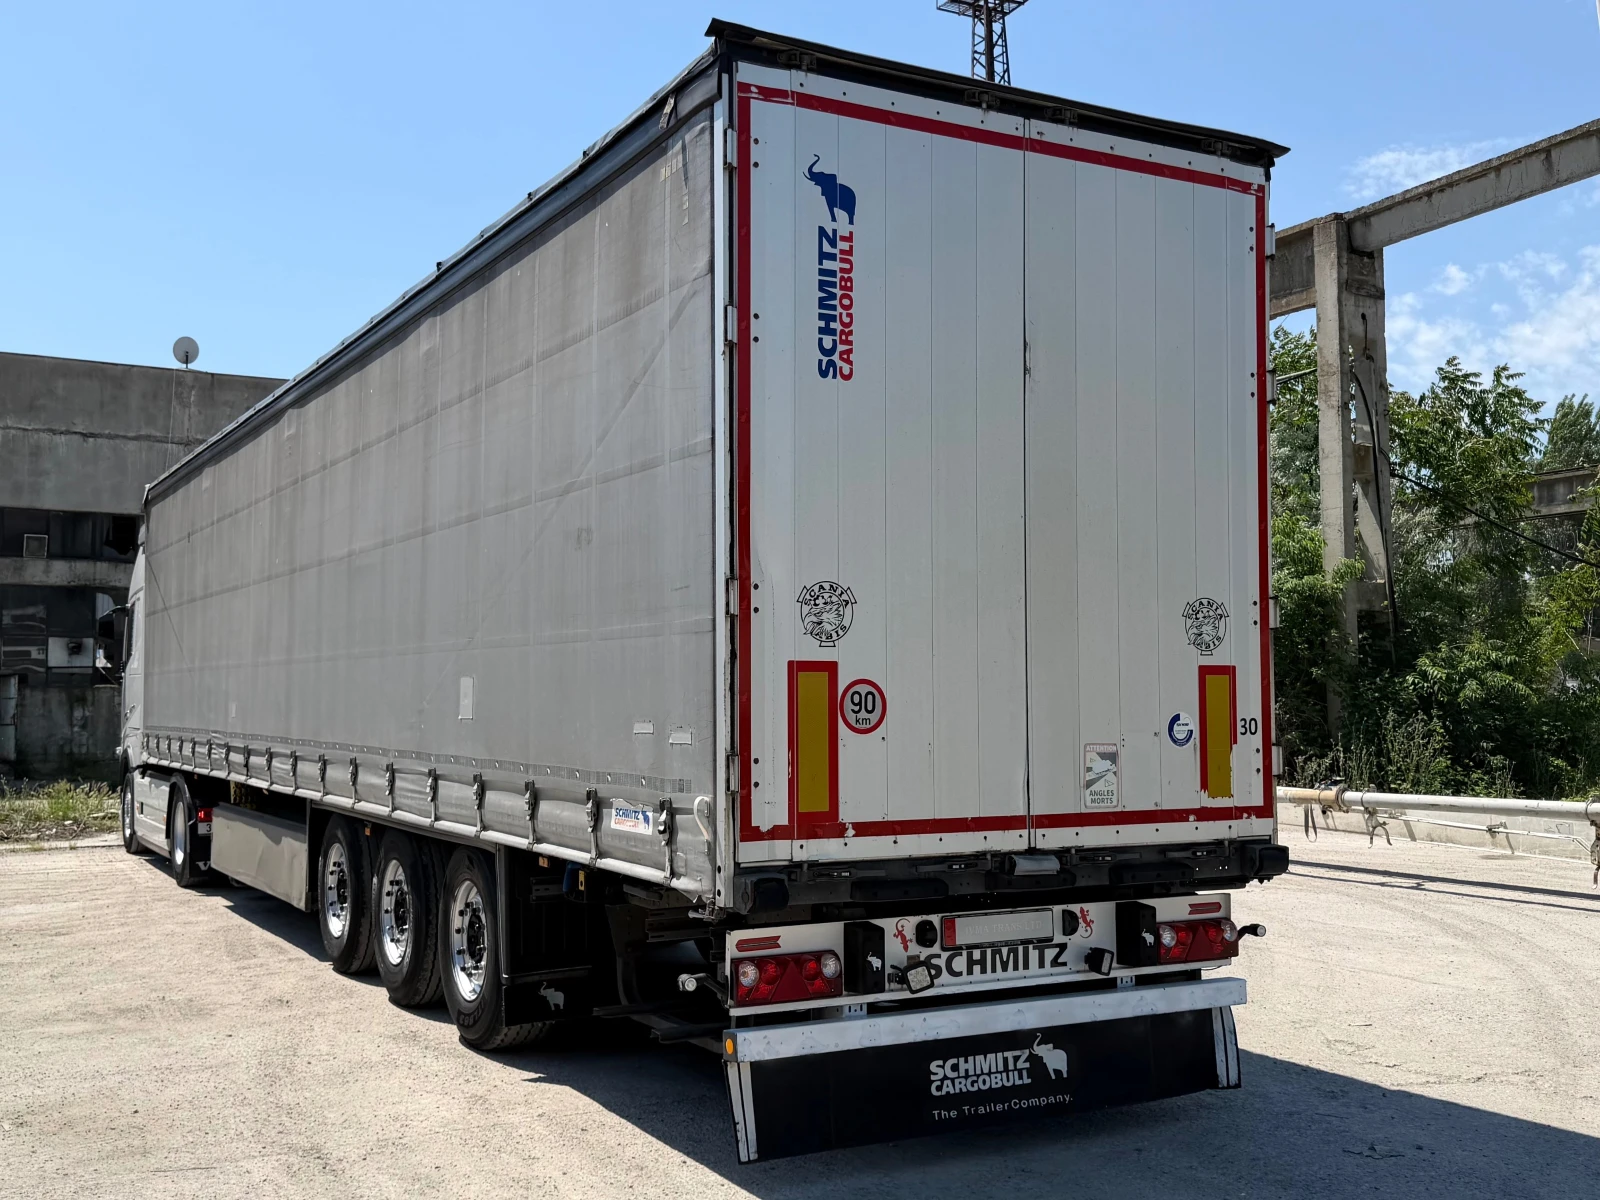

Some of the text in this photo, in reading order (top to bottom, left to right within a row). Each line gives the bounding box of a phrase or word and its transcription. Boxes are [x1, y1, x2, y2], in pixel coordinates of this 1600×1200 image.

[818, 225, 837, 380] SCHMITZ
[838, 231, 854, 381] CARGOBULL
[804, 584, 850, 609] SCANIA
[1187, 600, 1223, 622] SCANIA
[850, 690, 876, 715] 90
[855, 715, 871, 726] km
[1239, 717, 1258, 736] 30
[924, 942, 1068, 980] SCHMITZ
[929, 1049, 1030, 1081] SCHMITZ
[930, 1069, 1032, 1097] CARGOBULL
[932, 1110, 958, 1121] The
